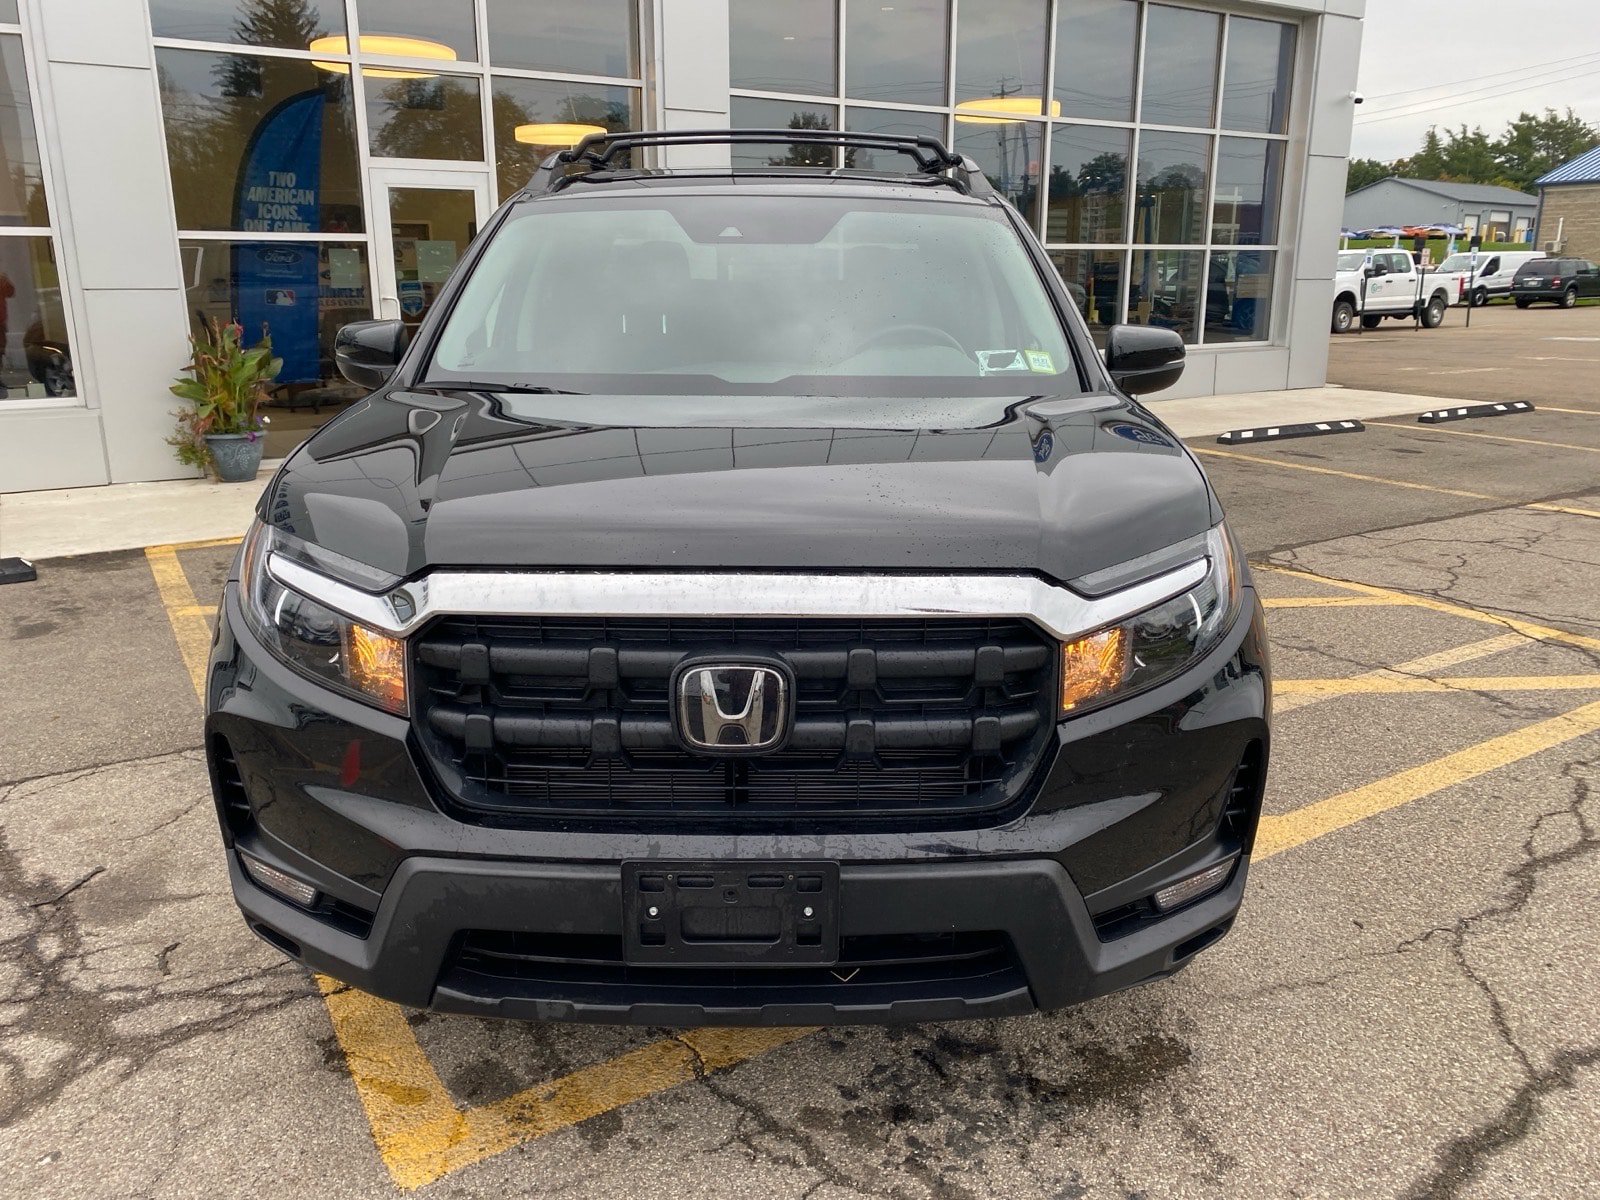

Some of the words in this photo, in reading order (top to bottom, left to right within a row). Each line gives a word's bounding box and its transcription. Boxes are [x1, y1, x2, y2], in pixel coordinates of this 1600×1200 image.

[269, 171, 296, 188] TWO
[247, 186, 315, 206] AMERICAN
[258, 203, 302, 221] ICONS.
[243, 218, 271, 232] ONE
[264, 250, 295, 263] Ford
